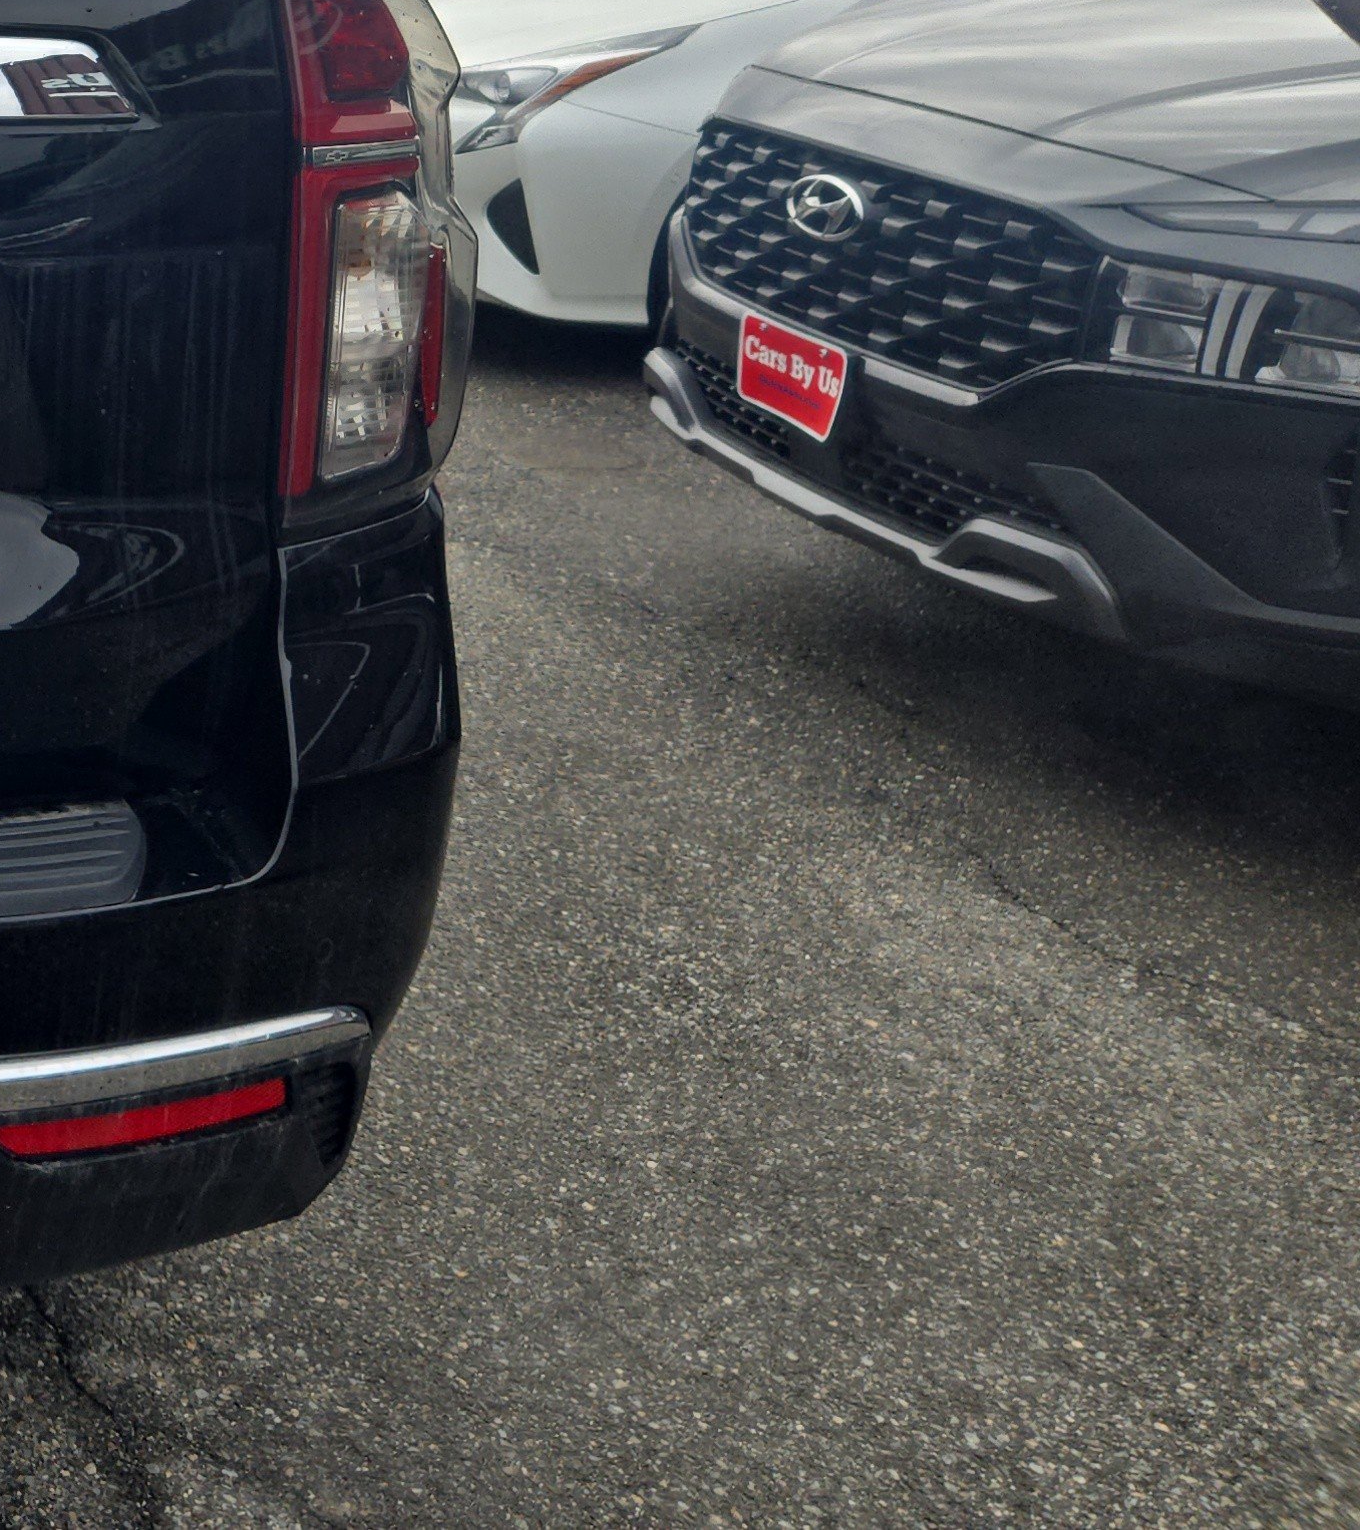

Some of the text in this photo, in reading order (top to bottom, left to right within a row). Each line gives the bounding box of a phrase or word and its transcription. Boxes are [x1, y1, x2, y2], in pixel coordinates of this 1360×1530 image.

[744, 334, 787, 374] Cars
[790, 353, 815, 390] By
[817, 365, 840, 398] Us
